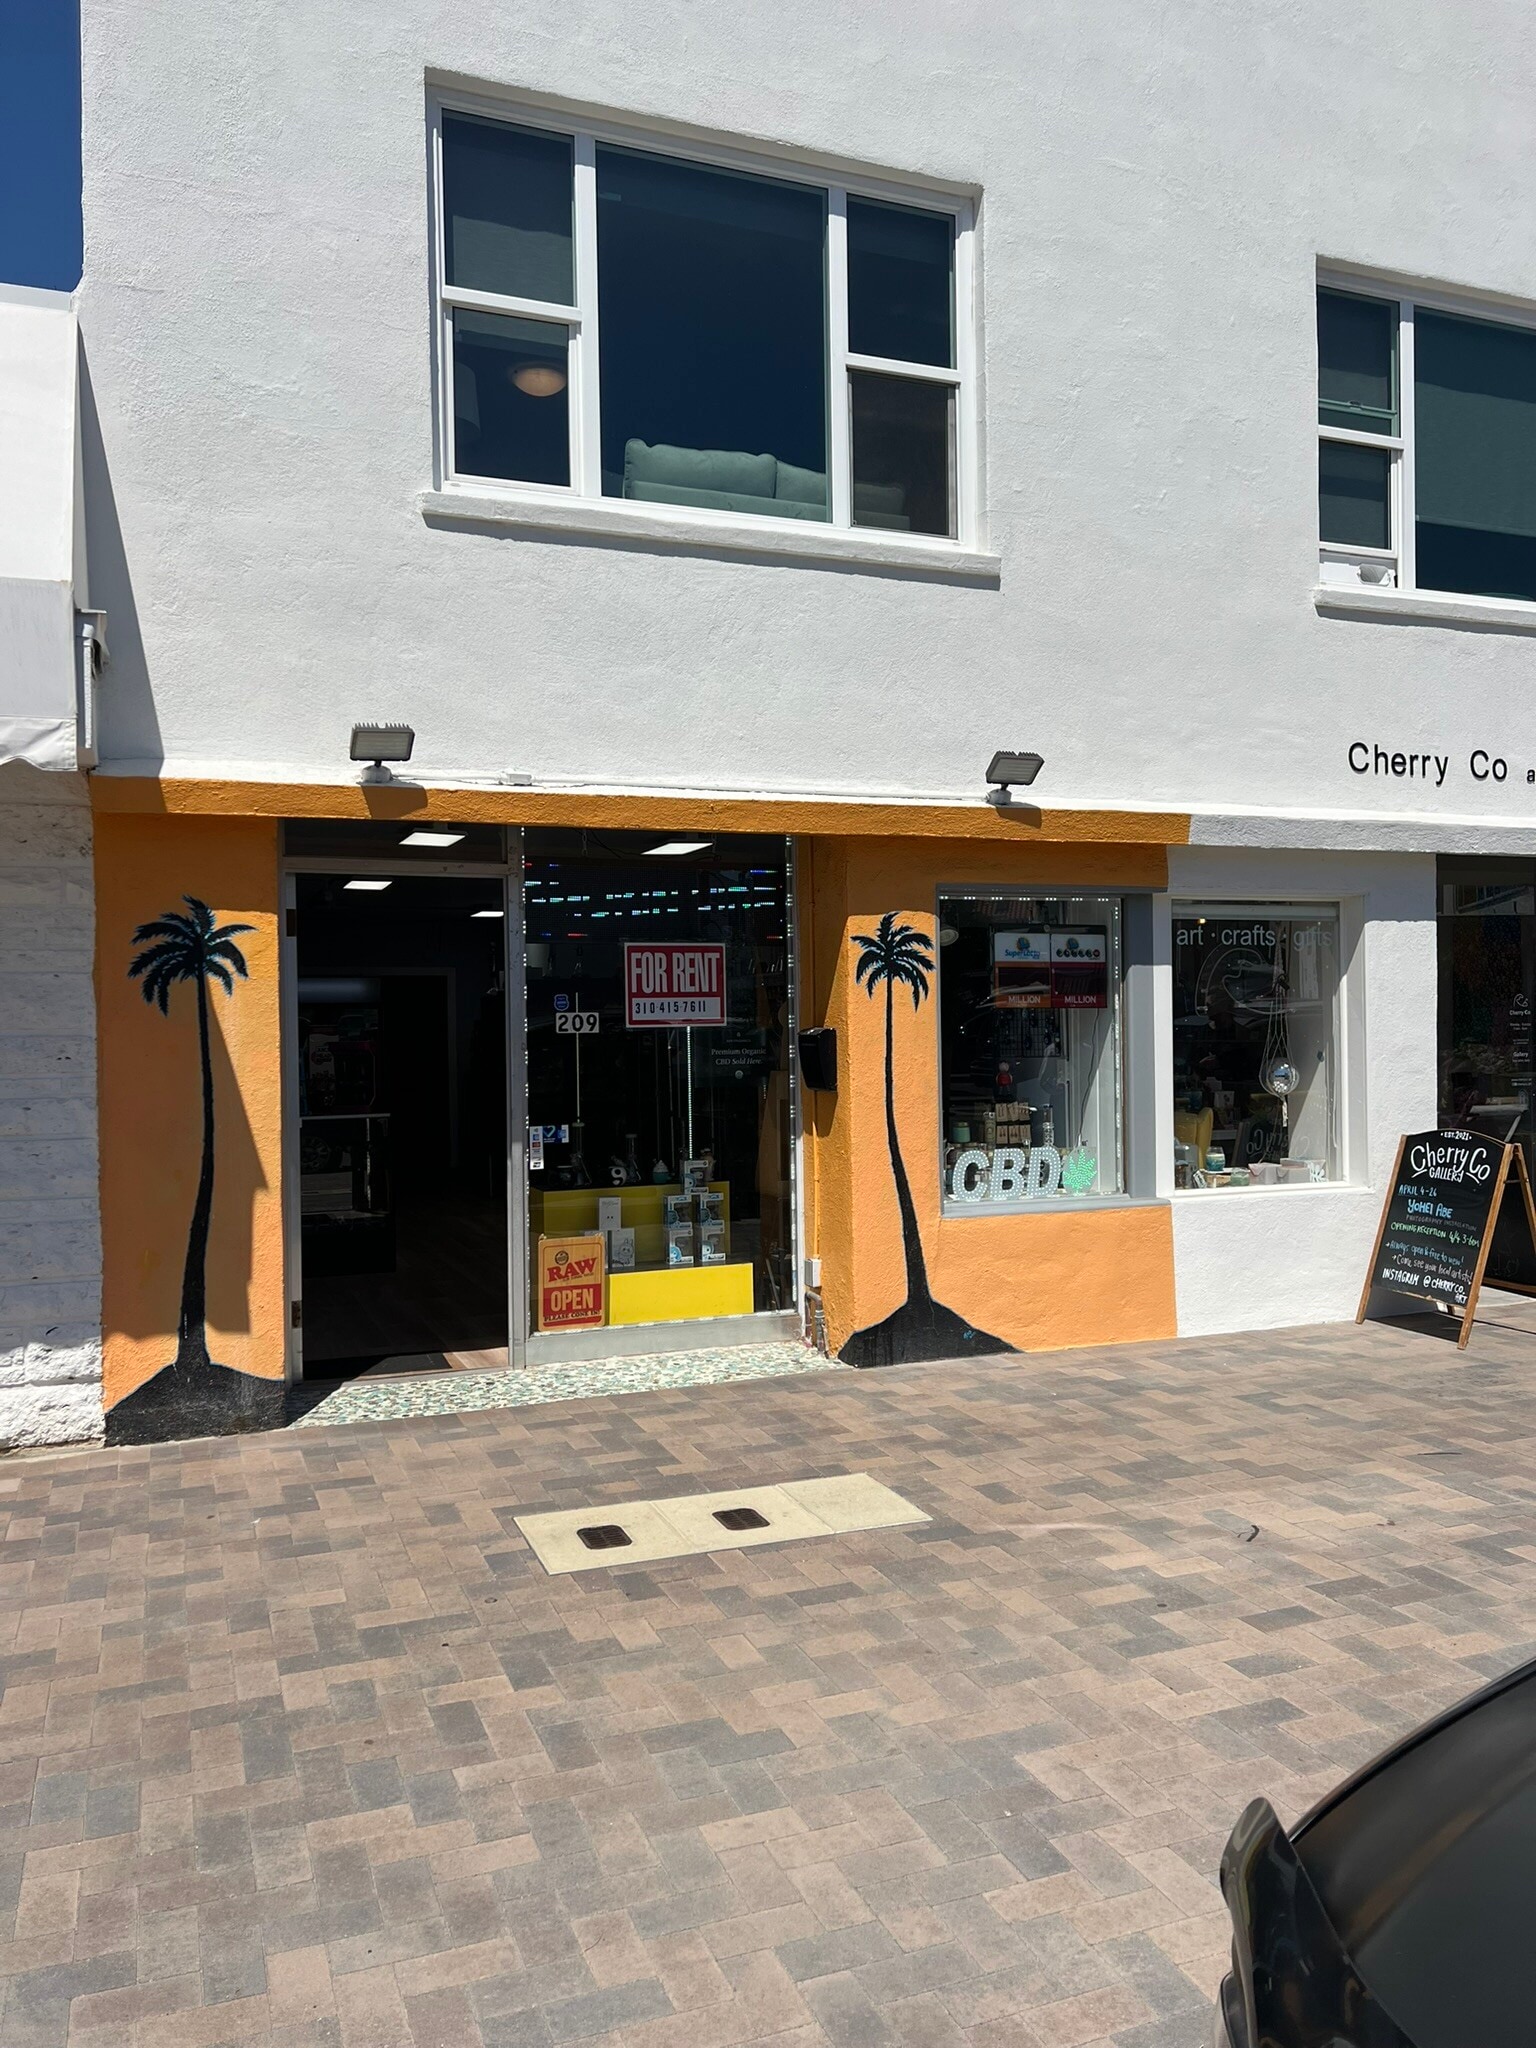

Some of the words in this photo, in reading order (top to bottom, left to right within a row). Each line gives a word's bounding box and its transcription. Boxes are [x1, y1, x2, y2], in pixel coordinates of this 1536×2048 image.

[1348, 742, 1449, 787] Cherry
[1470, 750, 1507, 782] Co
[1176, 925, 1203, 946] art
[1221, 924, 1276, 946] crafts
[1293, 926, 1333, 950] gifts
[631, 952, 668, 994] FOR
[672, 952, 720, 993] RENT
[1008, 995, 1041, 1004] MILLION
[1064, 995, 1097, 1004] MILLION
[558, 1014, 597, 1032] 209
[711, 1048, 741, 1056] Premium
[741, 1048, 767, 1056] Organic
[715, 1058, 731, 1066] CBD
[1411, 1142, 1469, 1173] Cherry
[1469, 1148, 1491, 1180] Co
[952, 1147, 1061, 1201] CBD
[1429, 1166, 1464, 1183] GALLERY
[1399, 1184, 1418, 1196] APRIL
[1435, 1203, 1453, 1218] ABE
[1390, 1222, 1416, 1233] OPENING
[1416, 1225, 1447, 1238] RECEPTION
[1411, 1245, 1424, 1256] open
[1441, 1251, 1448, 1263] to
[547, 1257, 598, 1282] RAW
[1396, 1254, 1412, 1268] Come
[1413, 1259, 1424, 1268] see
[1438, 1264, 1451, 1276] local
[1382, 1268, 1420, 1286] INSTAGRAM
[551, 1288, 594, 1312] OPEN
[544, 1313, 570, 1322] PLEASE
[571, 1310, 590, 1319] COME
